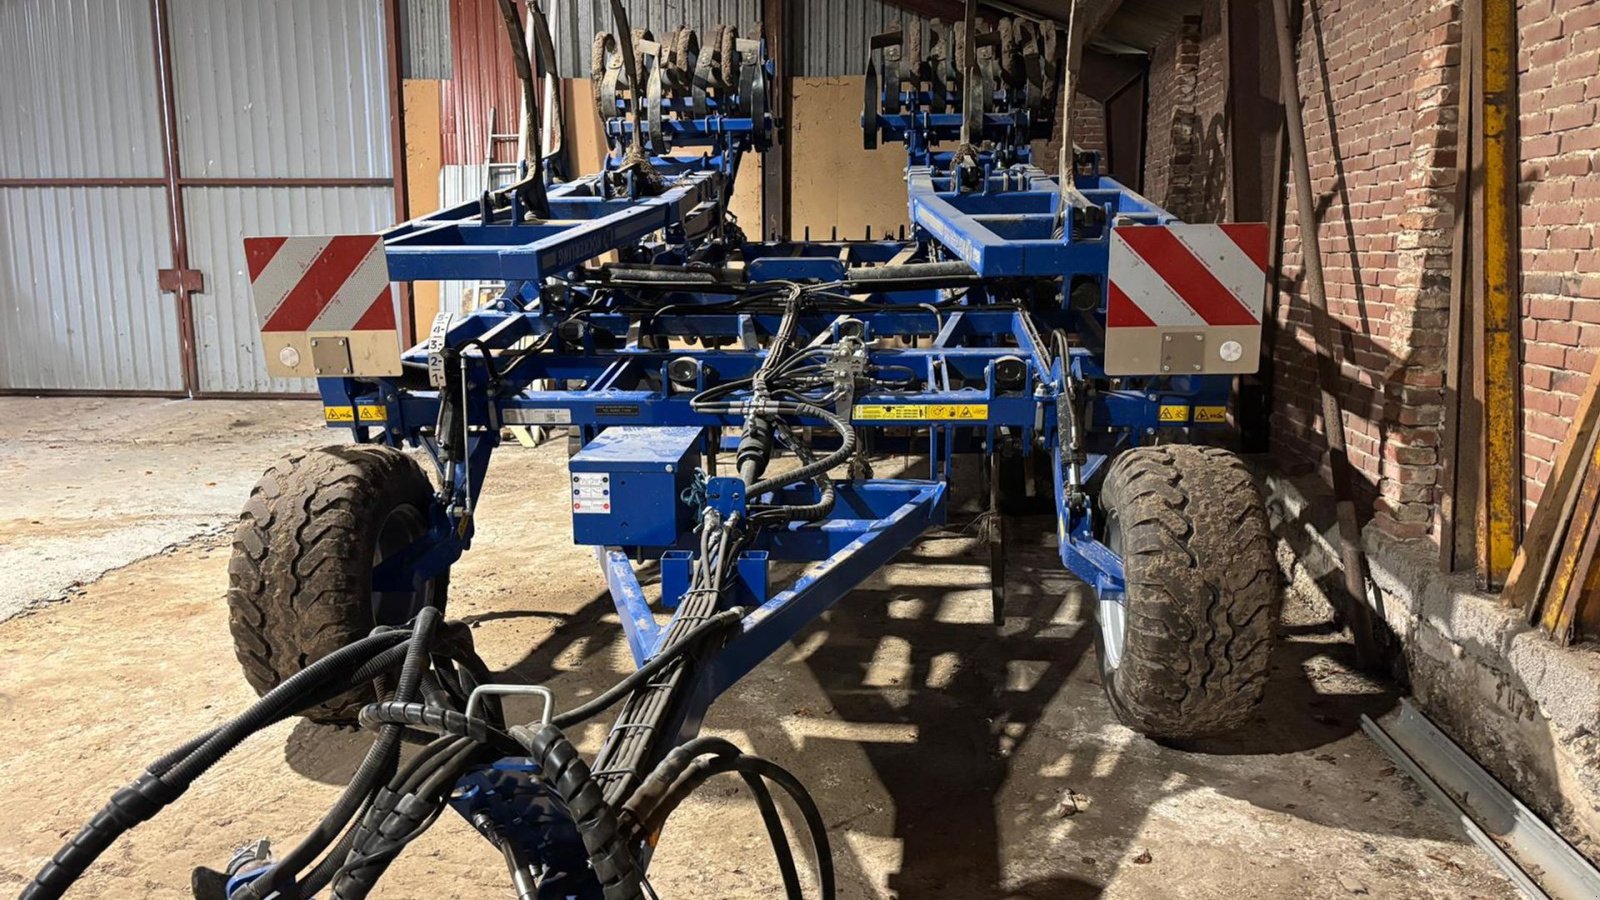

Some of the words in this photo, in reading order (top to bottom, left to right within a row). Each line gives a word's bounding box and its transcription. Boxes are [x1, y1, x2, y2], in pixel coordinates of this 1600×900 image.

[433, 325, 441, 334] 4
[430, 340, 437, 349] 3
[431, 356, 438, 366] 2
[432, 373, 438, 383] 1
